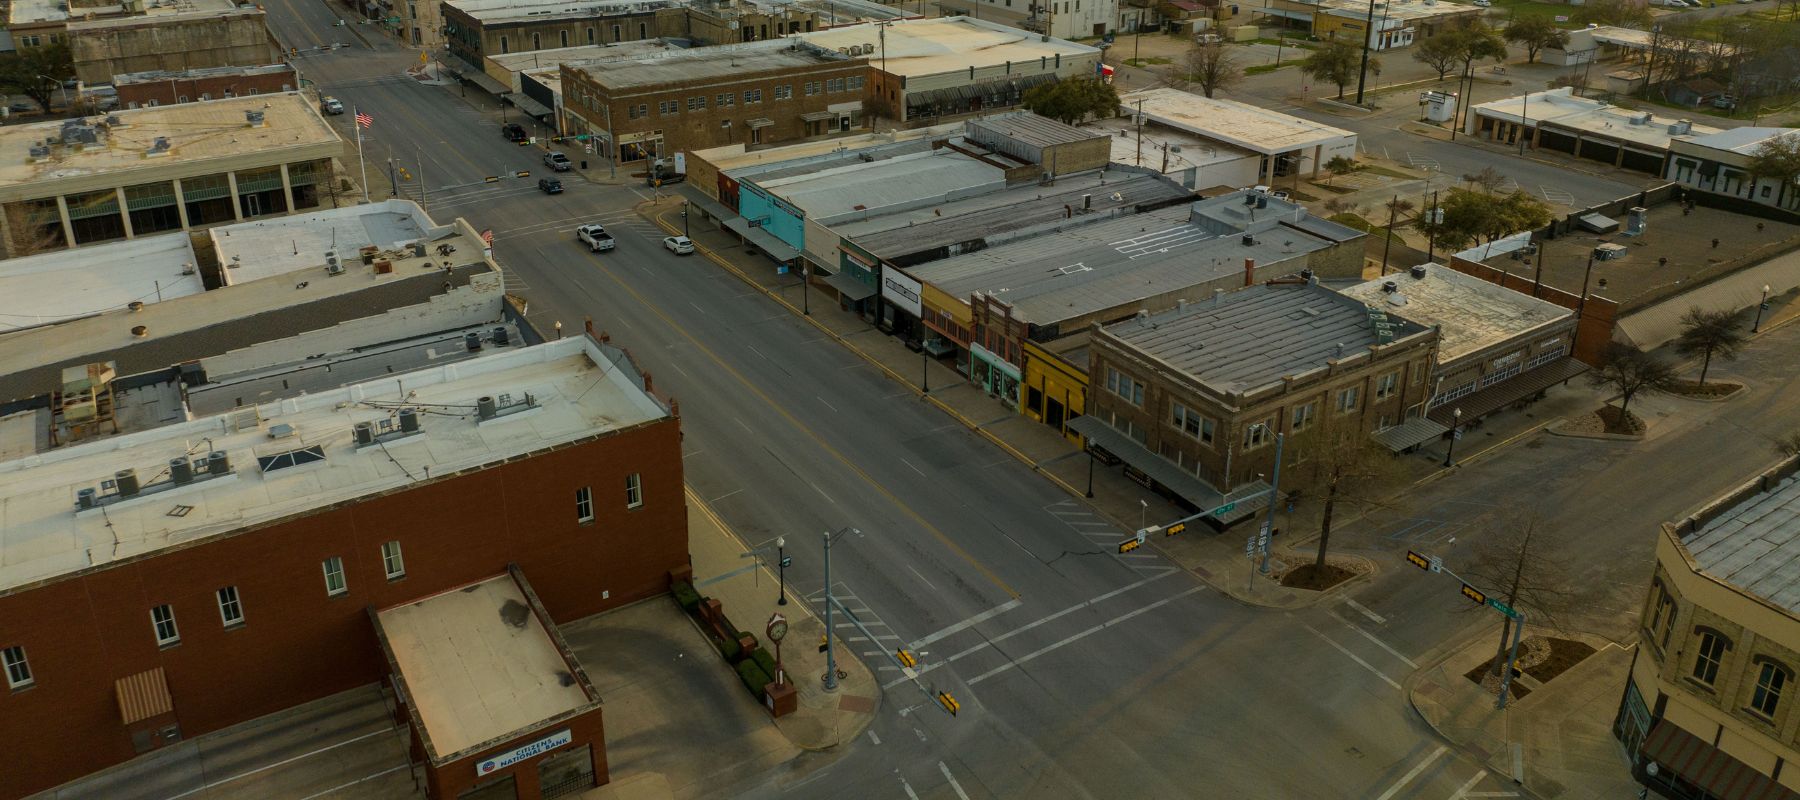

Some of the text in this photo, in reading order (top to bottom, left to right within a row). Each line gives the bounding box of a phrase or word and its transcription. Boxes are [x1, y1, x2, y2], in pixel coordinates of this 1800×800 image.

[1493, 601, 1507, 612] Main
[501, 737, 568, 767] NATIONAL BANK
[516, 738, 552, 756] CITIZENS
